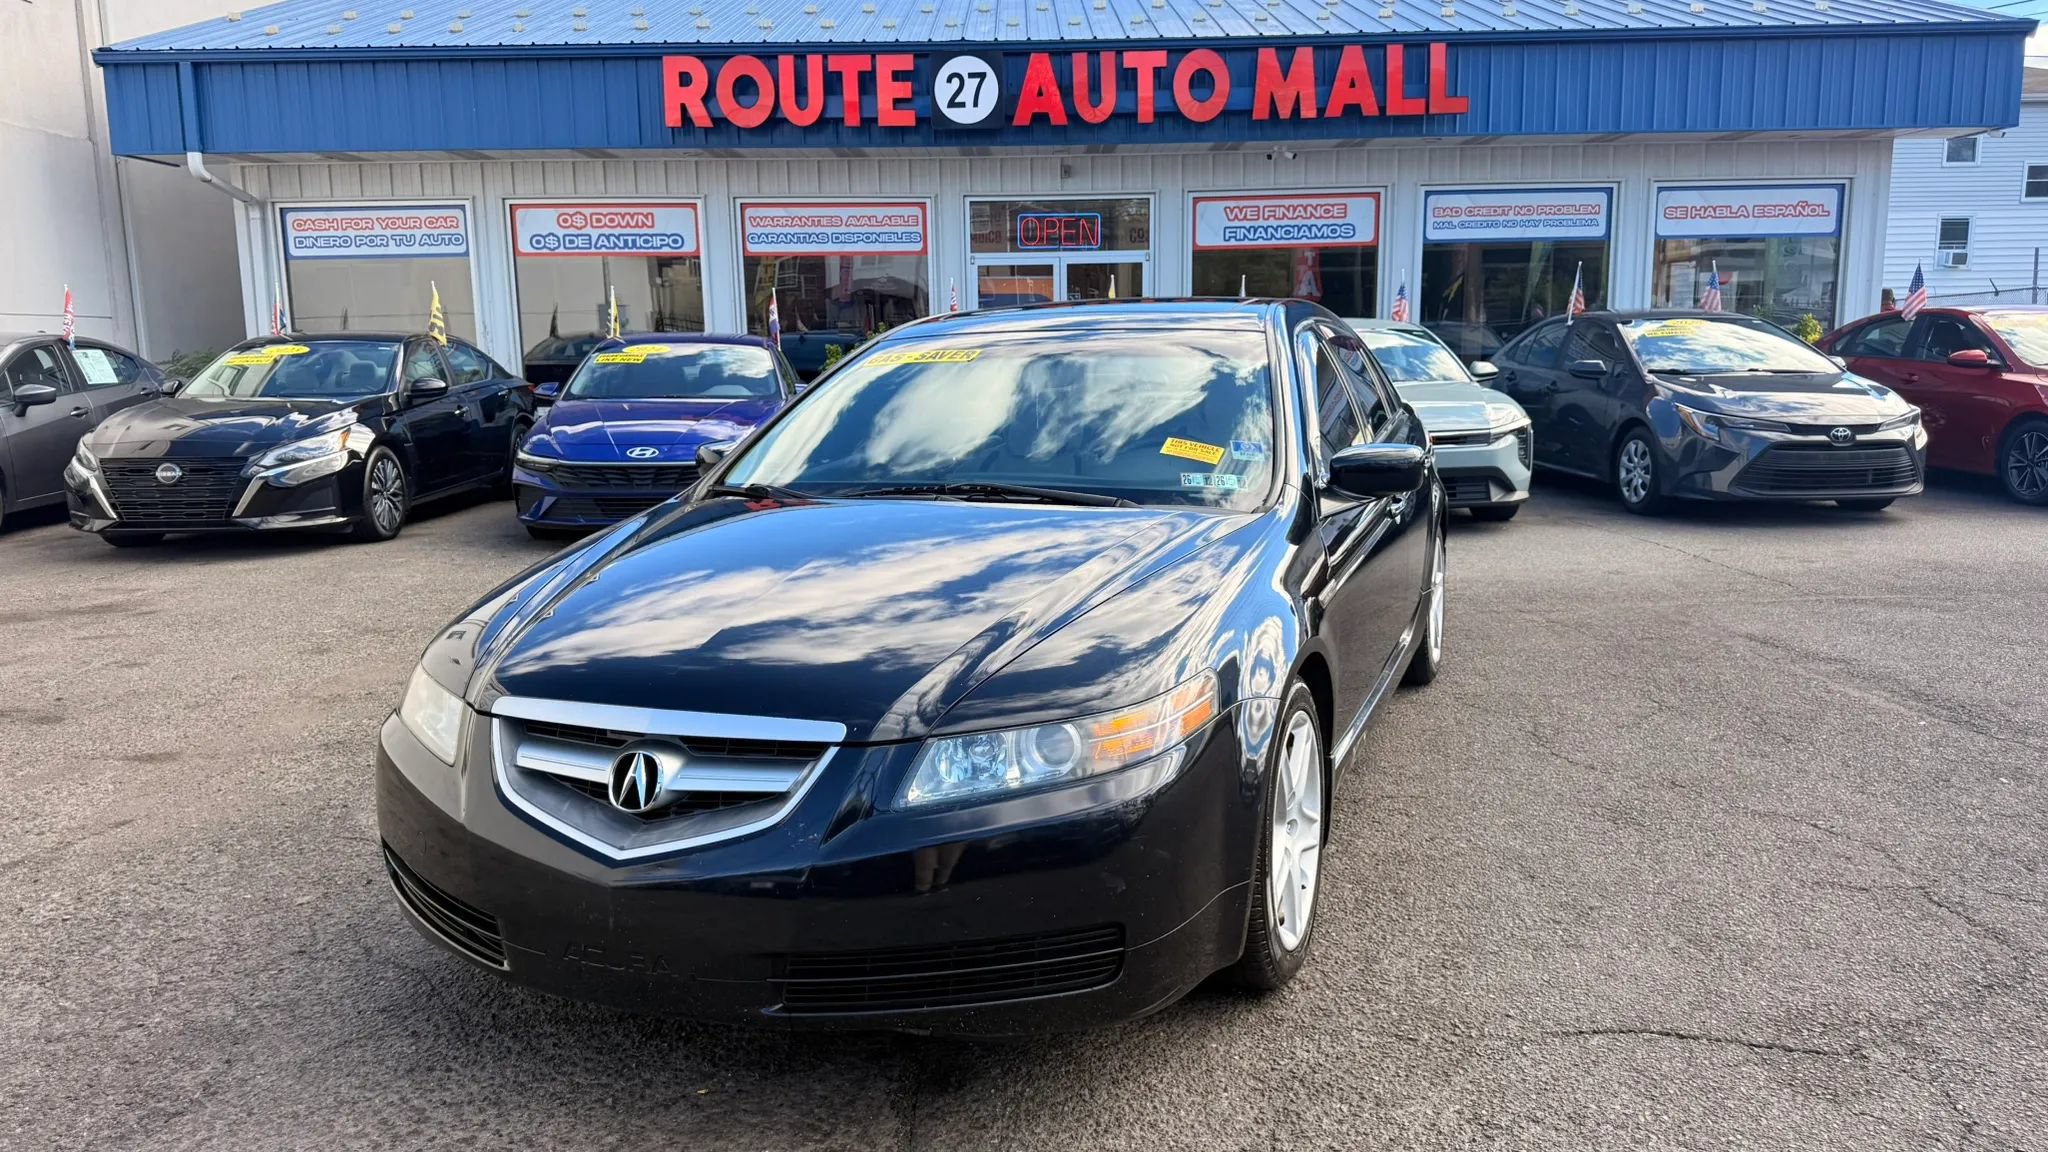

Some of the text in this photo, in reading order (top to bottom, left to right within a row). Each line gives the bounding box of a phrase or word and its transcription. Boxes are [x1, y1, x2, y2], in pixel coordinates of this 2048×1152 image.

[662, 42, 1468, 128] ROUTE 27 AUTO MALL
[1224, 204, 1347, 221] WE FINANCE
[1433, 204, 1600, 218] BAD CREDIT NO PROBLEM
[1664, 201, 1830, 220] SE HABLA ESPAÑOL
[293, 216, 459, 231] CASH FOR YOUR CAR
[591, 212, 654, 229] DOWN
[749, 215, 918, 228] WARRANTIES AVAILABLE
[1433, 218, 1598, 230] MAL CREDITO NO HAY PROBLEMA
[748, 232, 921, 244] GARANTIAS DISPONIBLES
[1020, 217, 1098, 246] OPEN
[1224, 224, 1355, 241] FINANCIAMOS
[294, 233, 464, 249] DINERO POR TU AUTO
[563, 234, 591, 249] DE
[594, 233, 684, 249] ANTICIPO
[914, 350, 977, 361] SAVER
[1182, 474, 1192, 485] 26
[1216, 475, 1226, 486] 26
